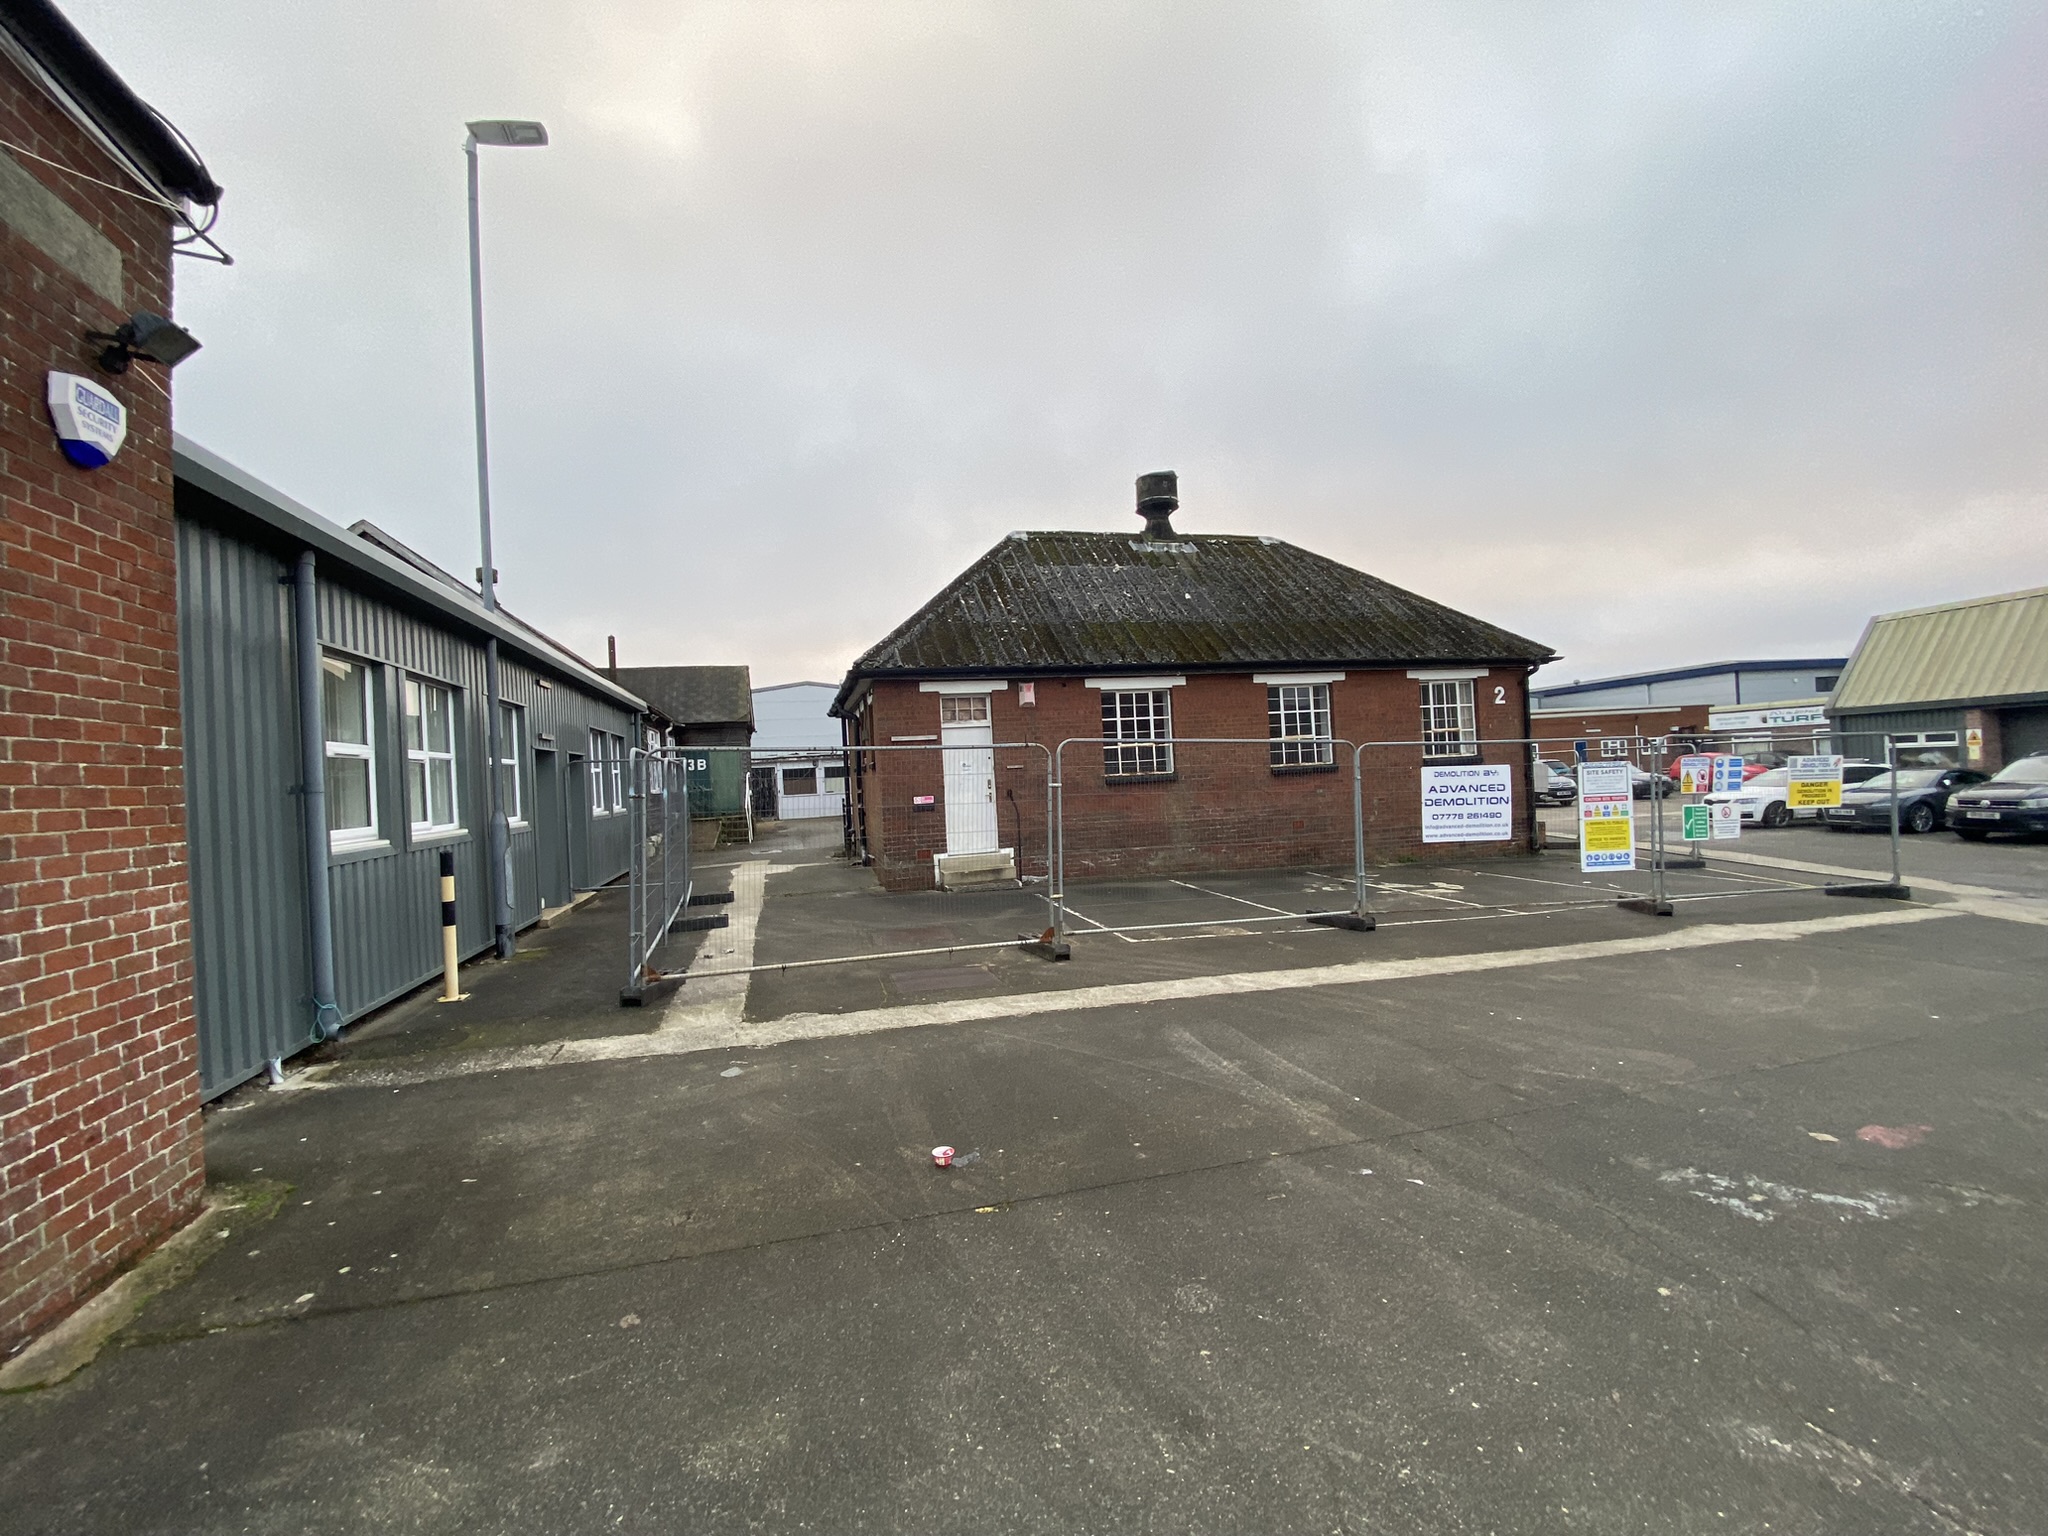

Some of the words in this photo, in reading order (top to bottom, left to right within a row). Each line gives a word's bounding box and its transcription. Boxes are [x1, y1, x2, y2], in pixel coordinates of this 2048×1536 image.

[77, 406, 117, 434] SECURITY
[81, 420, 114, 442] SYSTEMS
[1494, 686, 1506, 704] 2
[1769, 714, 1823, 723] TURF
[1428, 784, 1506, 794] ADVANCED
[1424, 797, 1509, 807] DEMOLITION
